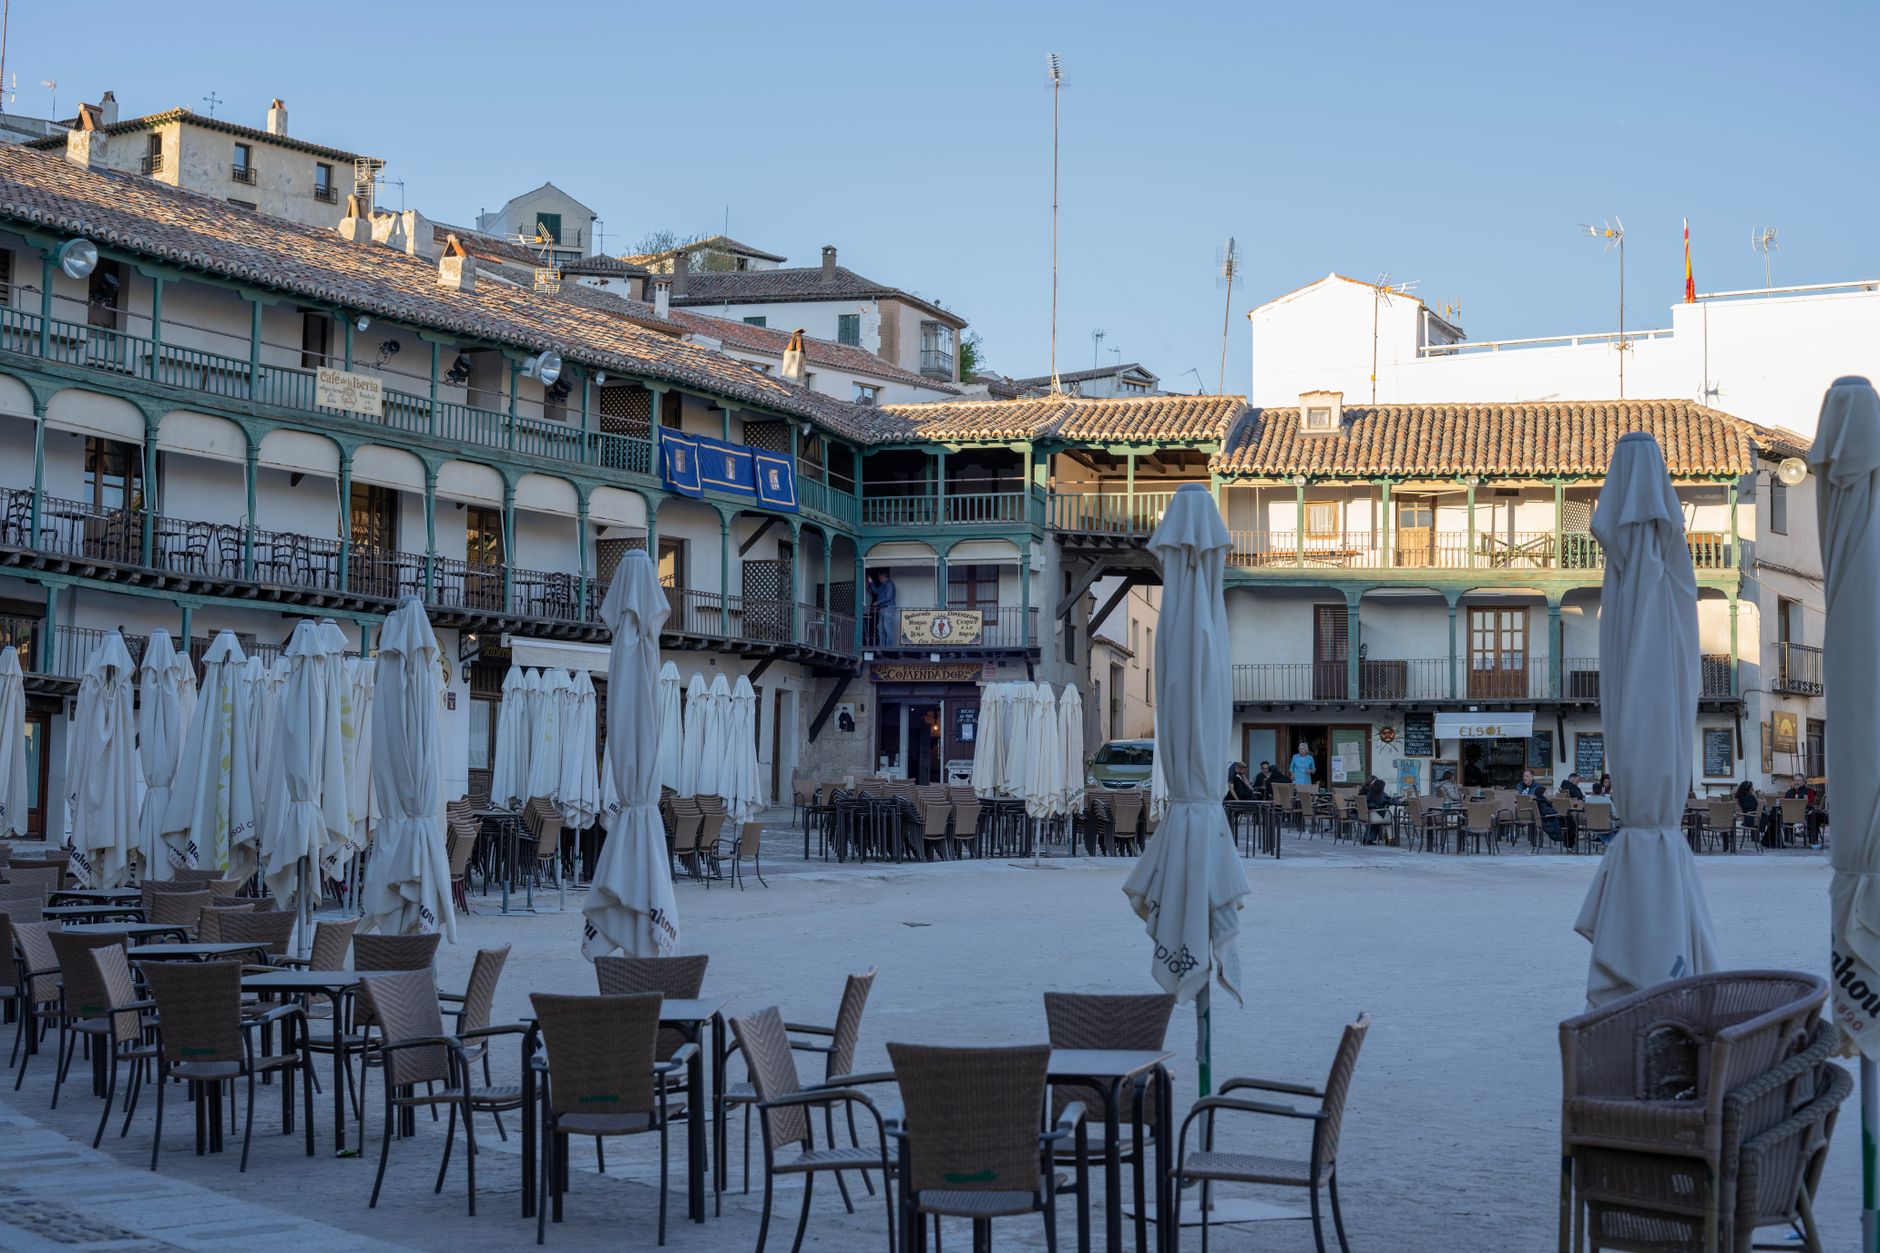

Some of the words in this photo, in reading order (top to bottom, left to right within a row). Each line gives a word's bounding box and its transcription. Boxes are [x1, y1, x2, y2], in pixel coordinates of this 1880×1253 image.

[320, 371, 340, 385] Café
[353, 376, 379, 392] Iberia
[887, 668, 964, 680] COMENDADOR
[650, 908, 677, 942] ahou
